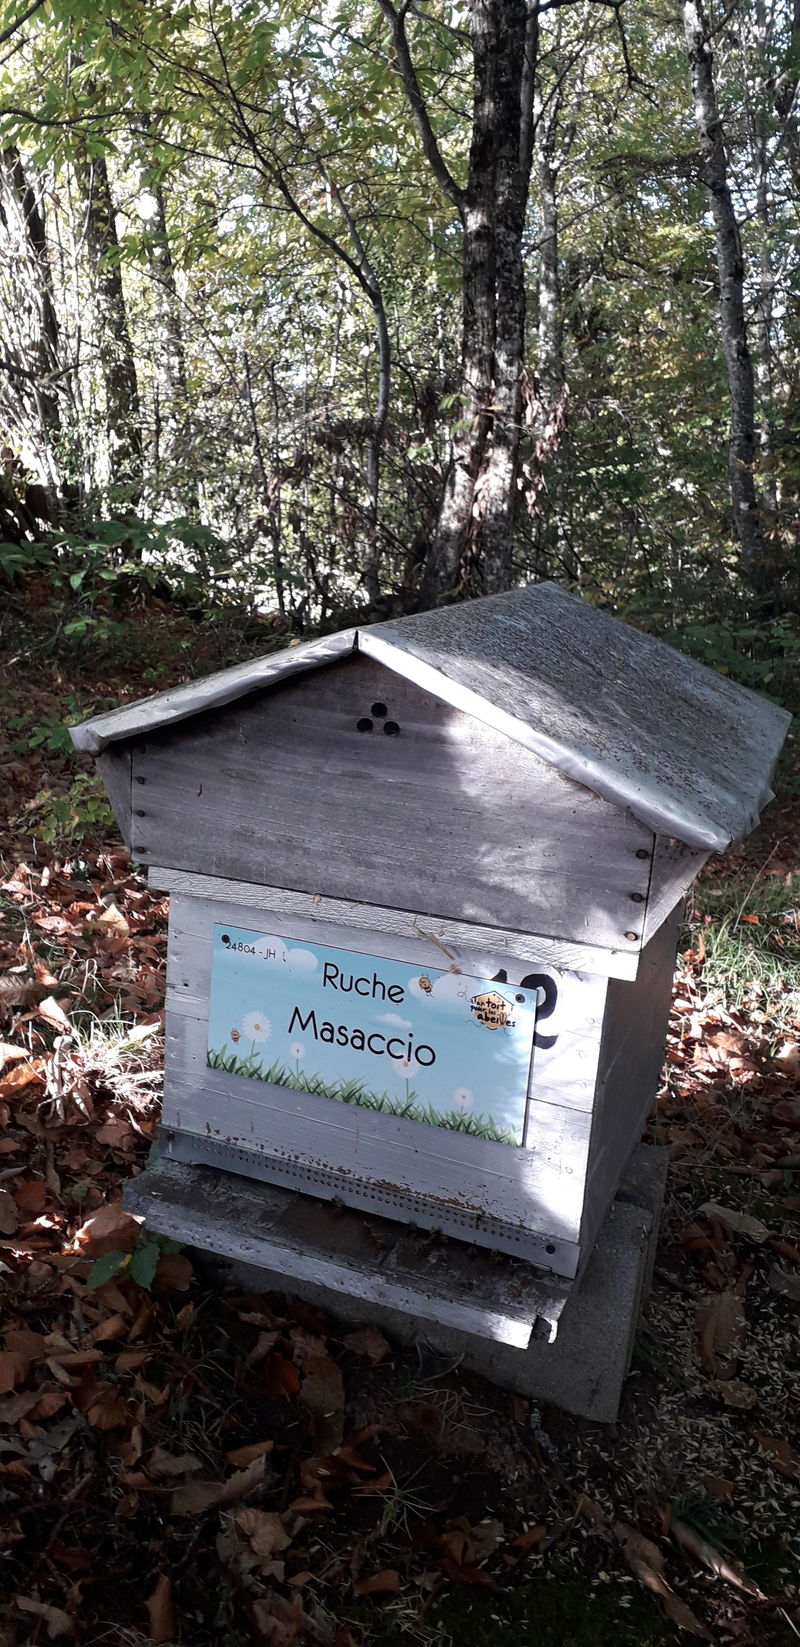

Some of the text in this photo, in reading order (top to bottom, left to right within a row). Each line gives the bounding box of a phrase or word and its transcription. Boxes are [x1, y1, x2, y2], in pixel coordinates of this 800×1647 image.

[225, 941, 256, 956] 24804
[263, 948, 276, 960] JH
[323, 962, 405, 1003] Ruche
[486, 998, 506, 1010] toit
[477, 1011, 516, 1027] abeilles
[288, 1006, 436, 1066] Masaccio
